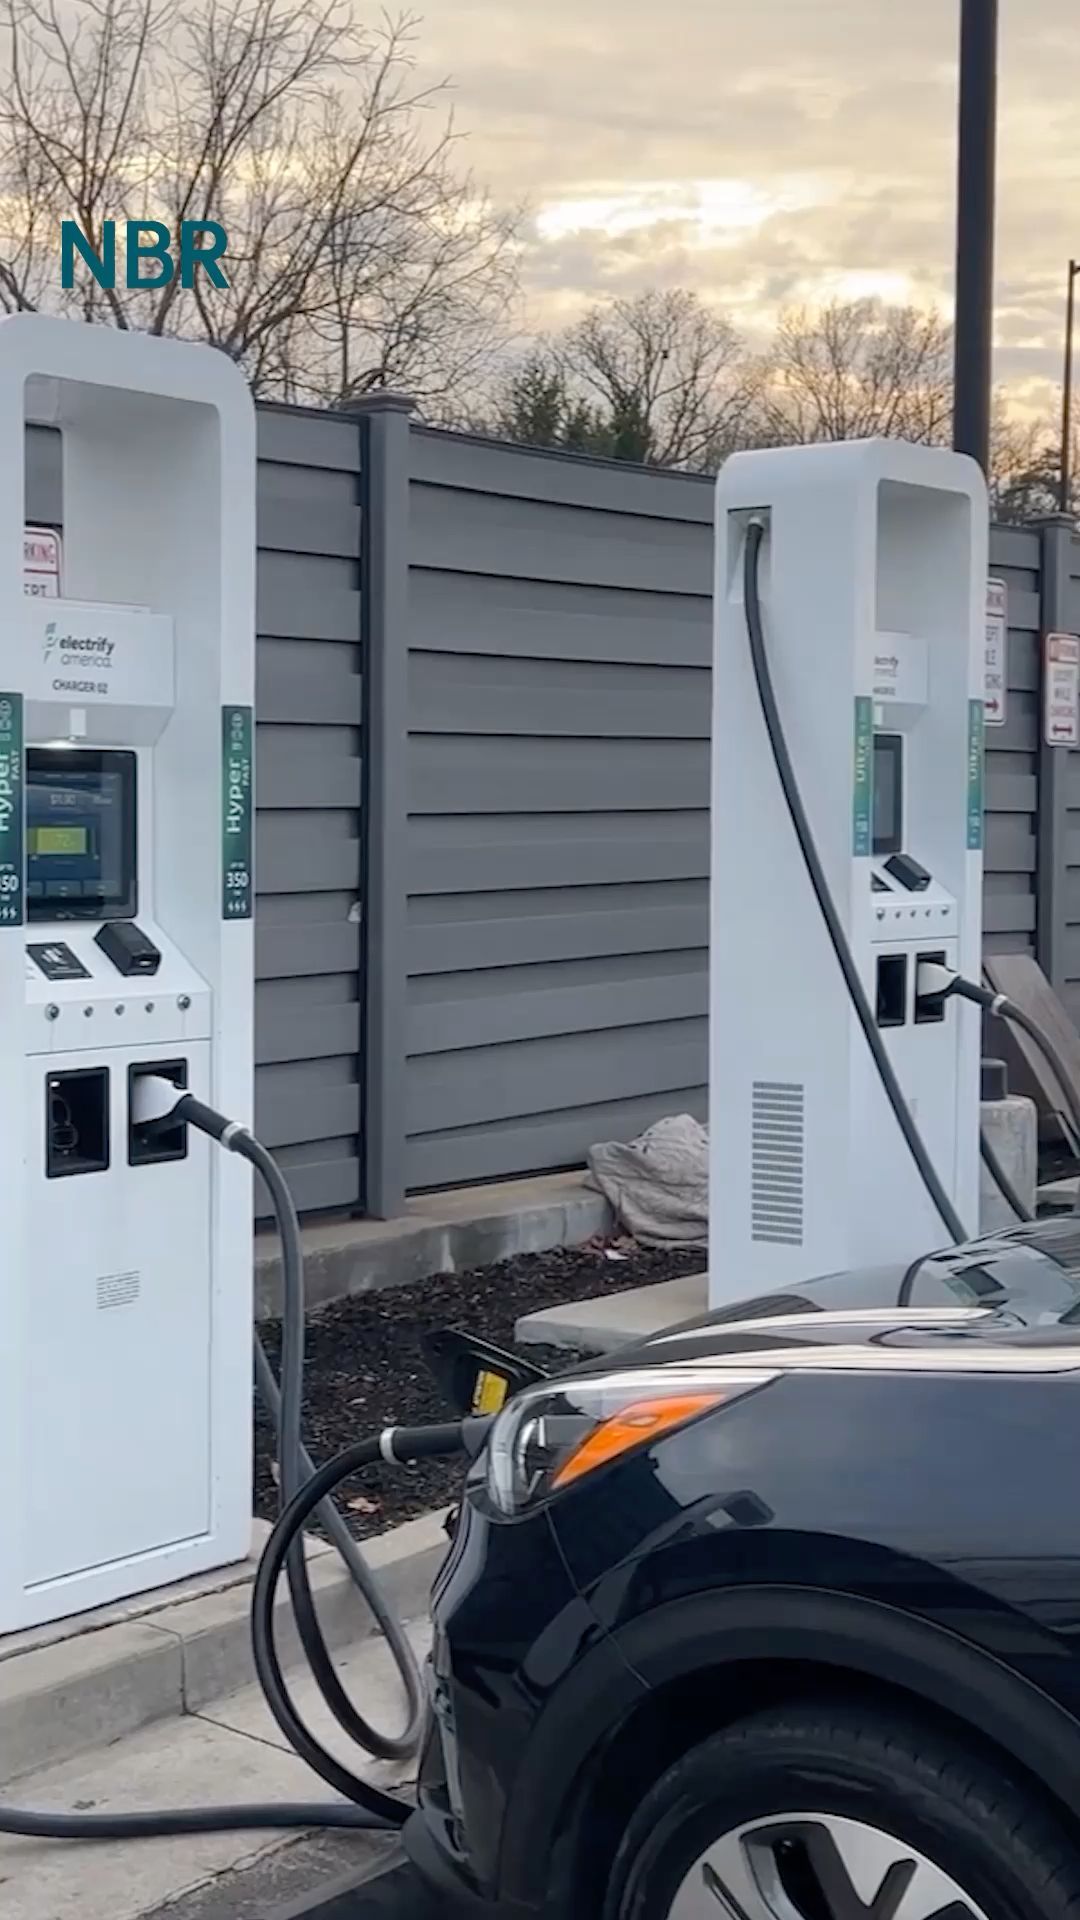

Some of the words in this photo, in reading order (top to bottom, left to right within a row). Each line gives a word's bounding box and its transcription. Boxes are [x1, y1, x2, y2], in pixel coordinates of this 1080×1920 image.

[59, 636, 115, 655] electrify
[52, 679, 96, 692] CHARGER
[242, 757, 250, 786] FAST
[226, 758, 245, 833] Hyper
[0, 874, 20, 892] 50
[226, 871, 250, 888] 350
